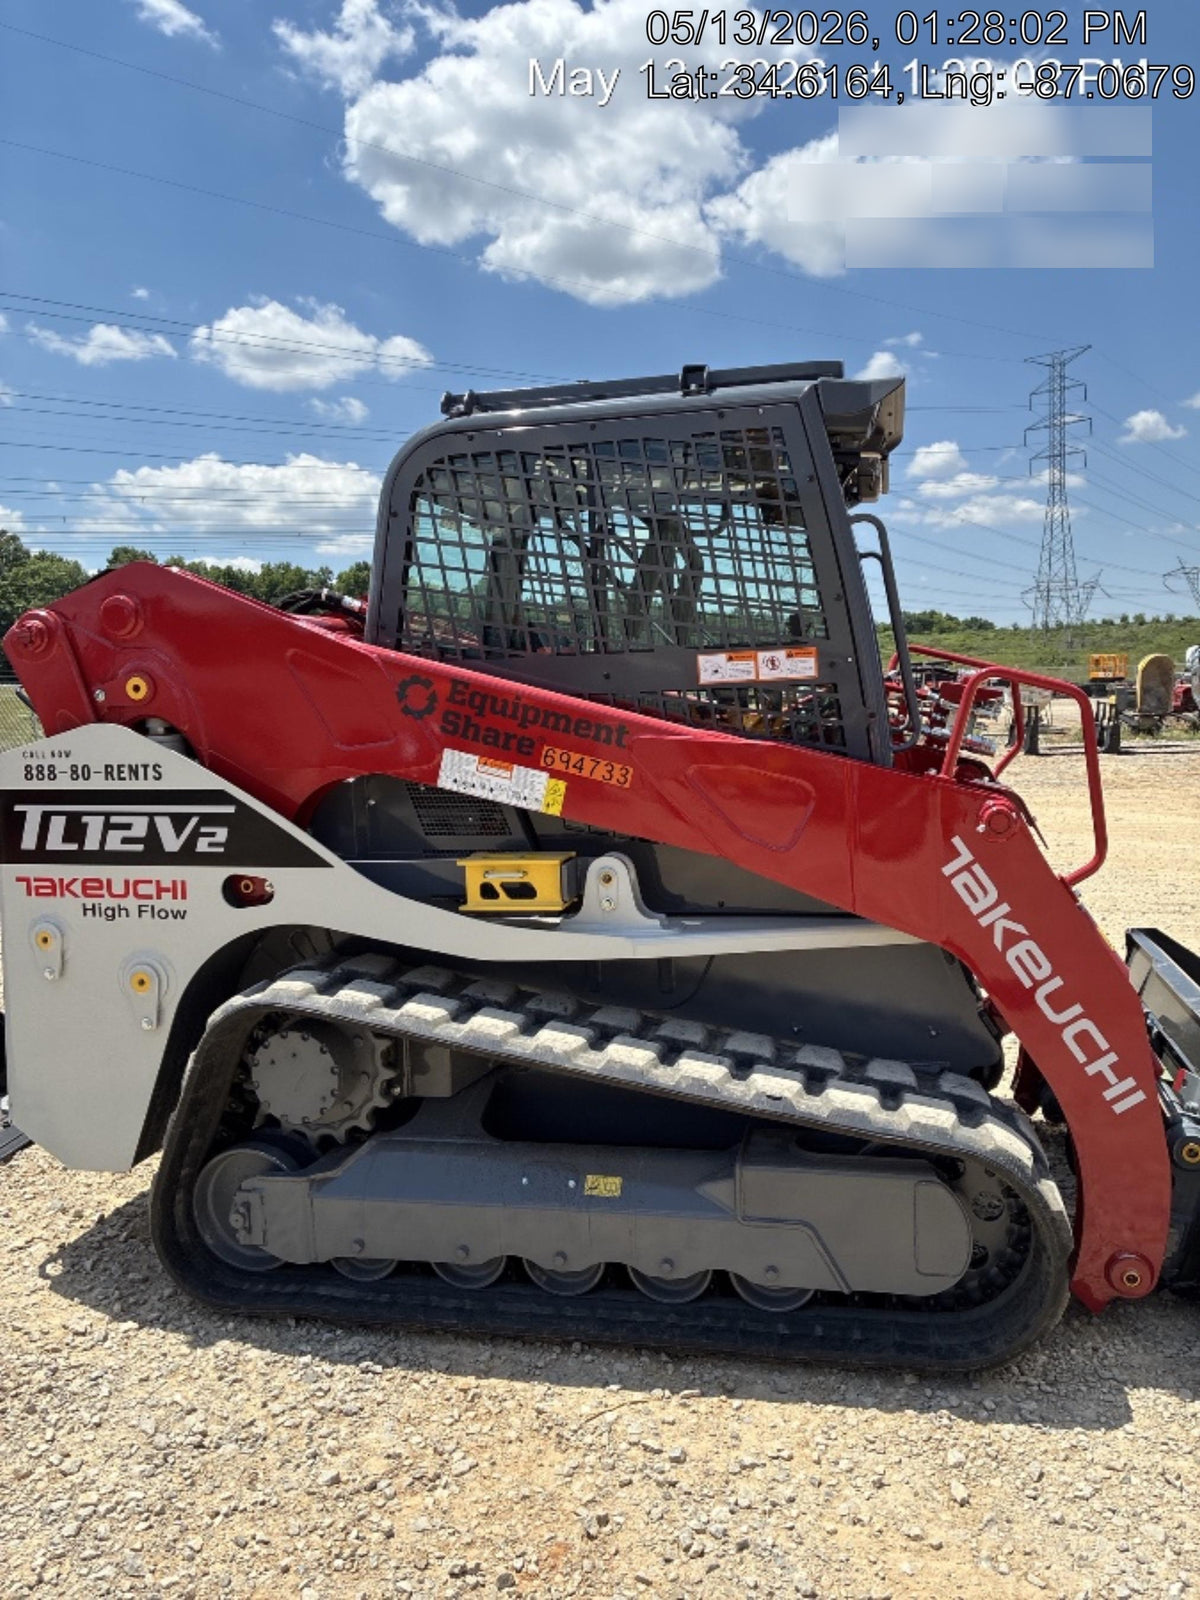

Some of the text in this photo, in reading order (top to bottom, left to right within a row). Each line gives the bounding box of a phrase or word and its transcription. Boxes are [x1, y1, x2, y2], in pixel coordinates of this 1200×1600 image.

[440, 709, 536, 756] Share
[446, 679, 629, 748] Equipment
[24, 764, 163, 781] 888-80-RENTS
[542, 747, 631, 786] 694733
[14, 805, 235, 852] TL12V2
[15, 876, 188, 900] TAKEUCHI
[82, 902, 188, 921] High Flow
[941, 835, 1147, 1115] TAKEUCHI
